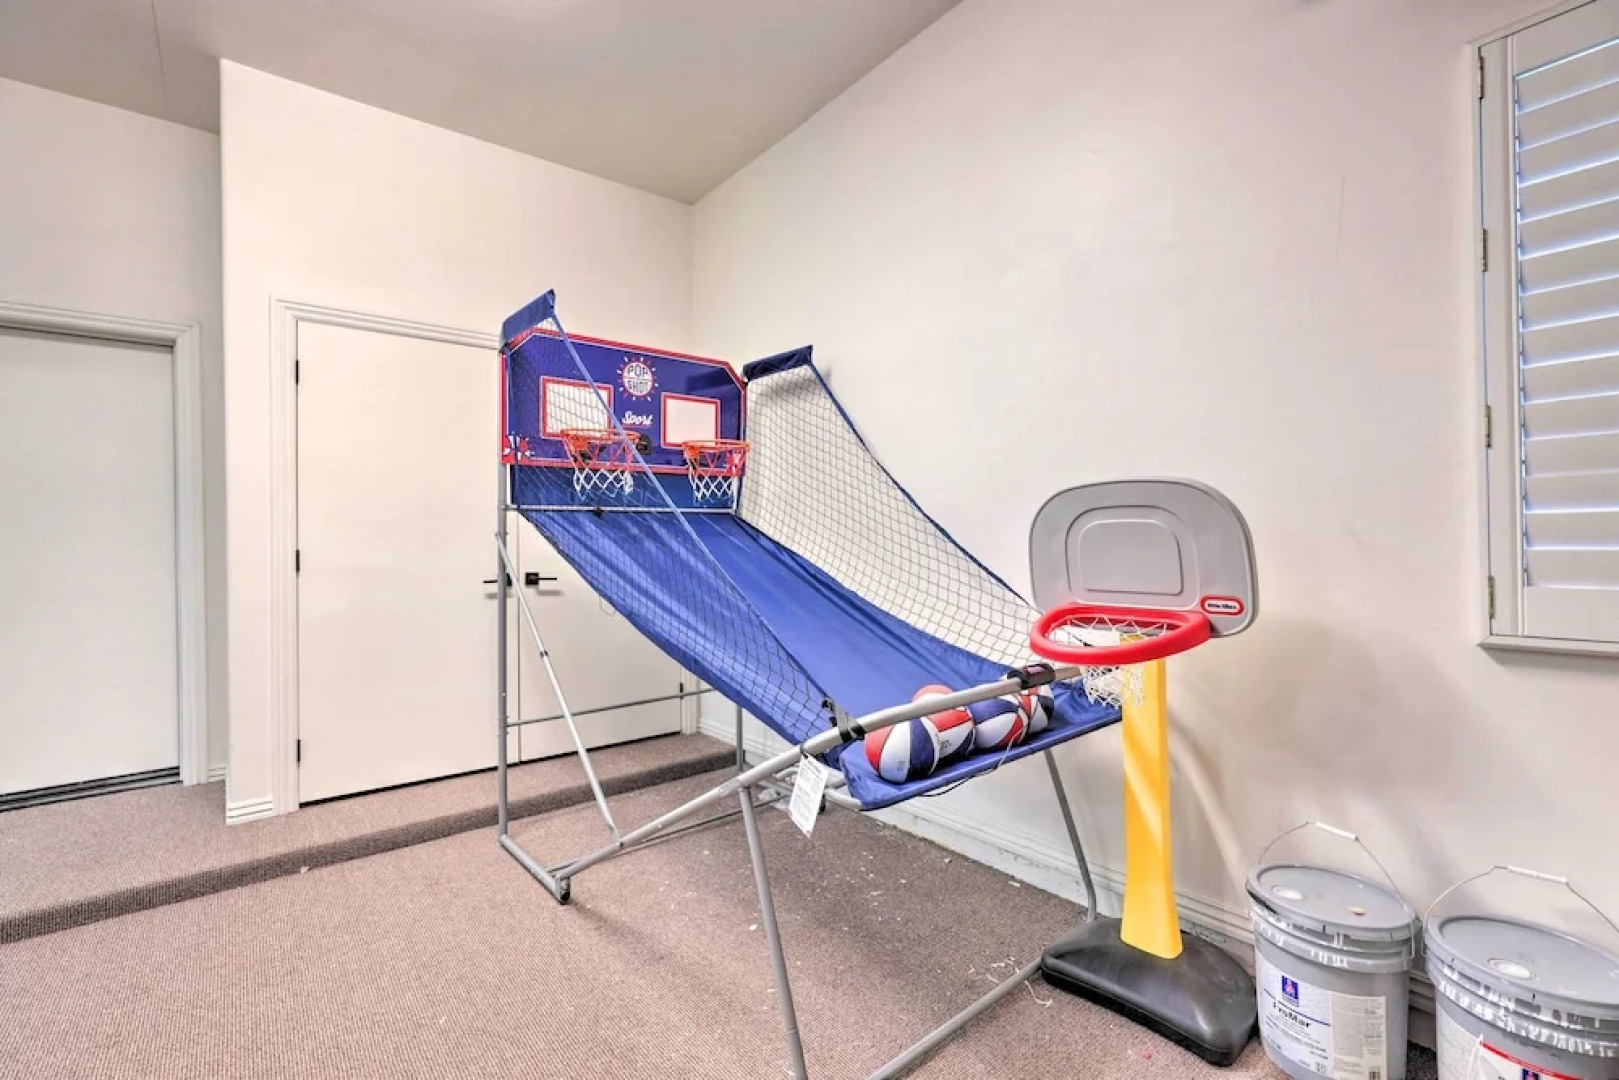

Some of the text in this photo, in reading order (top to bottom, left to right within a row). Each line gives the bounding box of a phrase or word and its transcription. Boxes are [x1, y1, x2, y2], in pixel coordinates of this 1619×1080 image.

[627, 364, 649, 377] POP
[627, 380, 649, 394] SHOT
[622, 410, 653, 425] Sport
